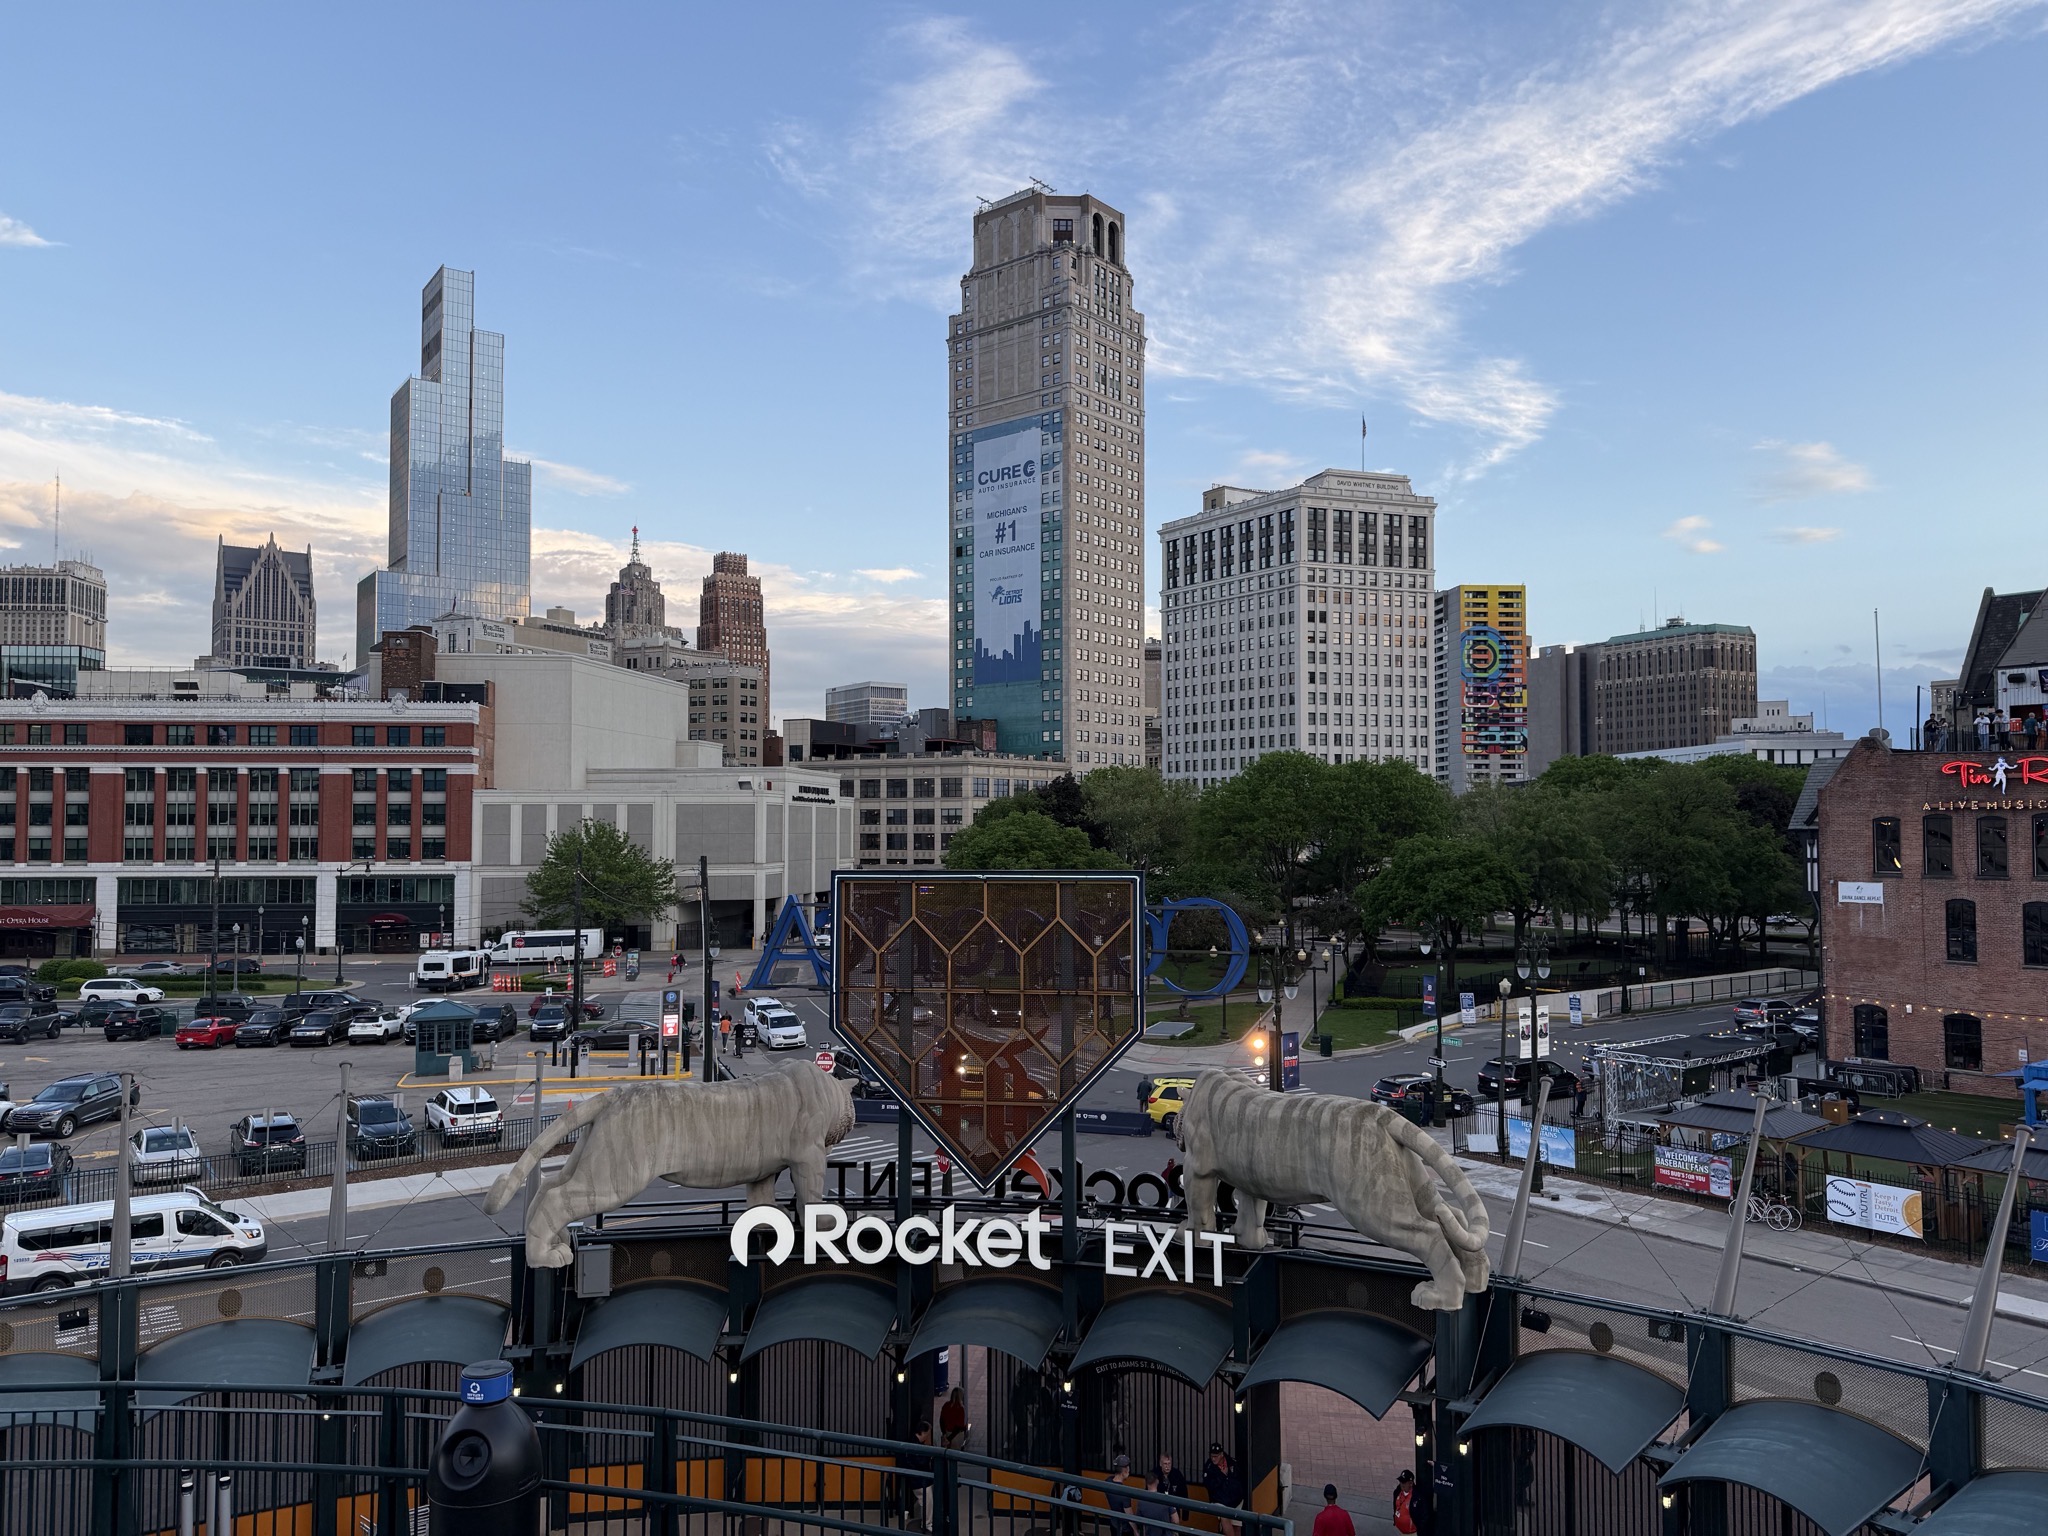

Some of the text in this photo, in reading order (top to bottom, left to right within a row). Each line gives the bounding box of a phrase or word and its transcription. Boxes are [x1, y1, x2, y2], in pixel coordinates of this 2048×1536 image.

[978, 464, 1021, 485] CURE
[978, 477, 1036, 494] AUTO INSURANCE
[986, 505, 1028, 519] MICHIGAN'S
[995, 520, 1016, 544] #1
[980, 543, 1035, 558] CAR INSURANCE
[999, 594, 1023, 605] LIONS
[1941, 761, 1991, 788] Tin
[1922, 800, 2047, 811] A LIVE MUSIC
[28, 916, 49, 924] HOUSE
[1626, 1088, 1657, 1100] DETROIT
[1664, 1150, 1698, 1164] WELCOME
[1655, 1157, 1709, 1174] BASEBALL FANS
[1659, 1168, 1670, 1176] THIS
[1671, 1171, 1685, 1179] BUD'S
[1874, 1192, 1891, 1201] Keep
[804, 1203, 1236, 1287] Rocket EXIT
[1095, 1365, 1108, 1374] EXIT
[1434, 1479, 1453, 1488] Re-Entry
